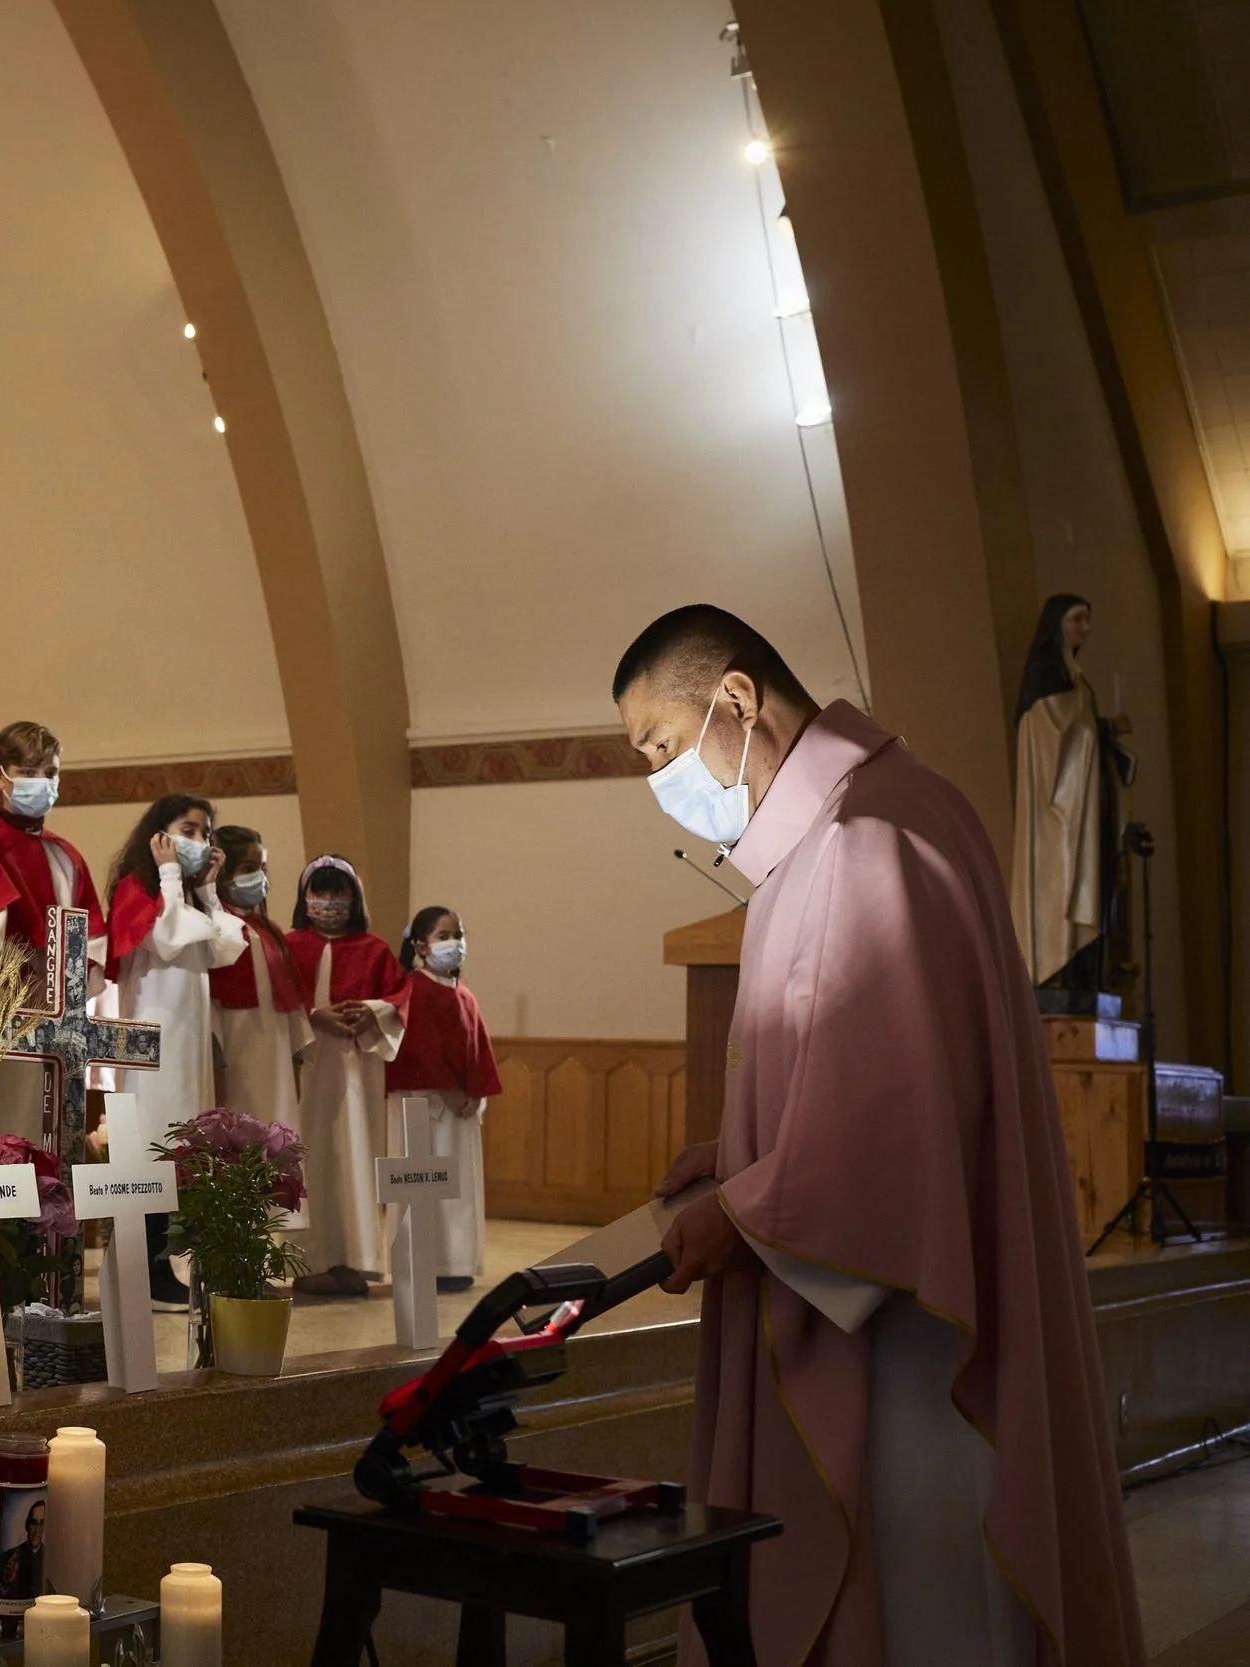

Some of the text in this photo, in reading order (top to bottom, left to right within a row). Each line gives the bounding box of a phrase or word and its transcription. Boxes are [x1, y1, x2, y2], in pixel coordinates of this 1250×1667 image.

[45, 907, 57, 1004] SANGRE
[89, 1182, 163, 1196] Beato P COSME SPEZZOTTO
